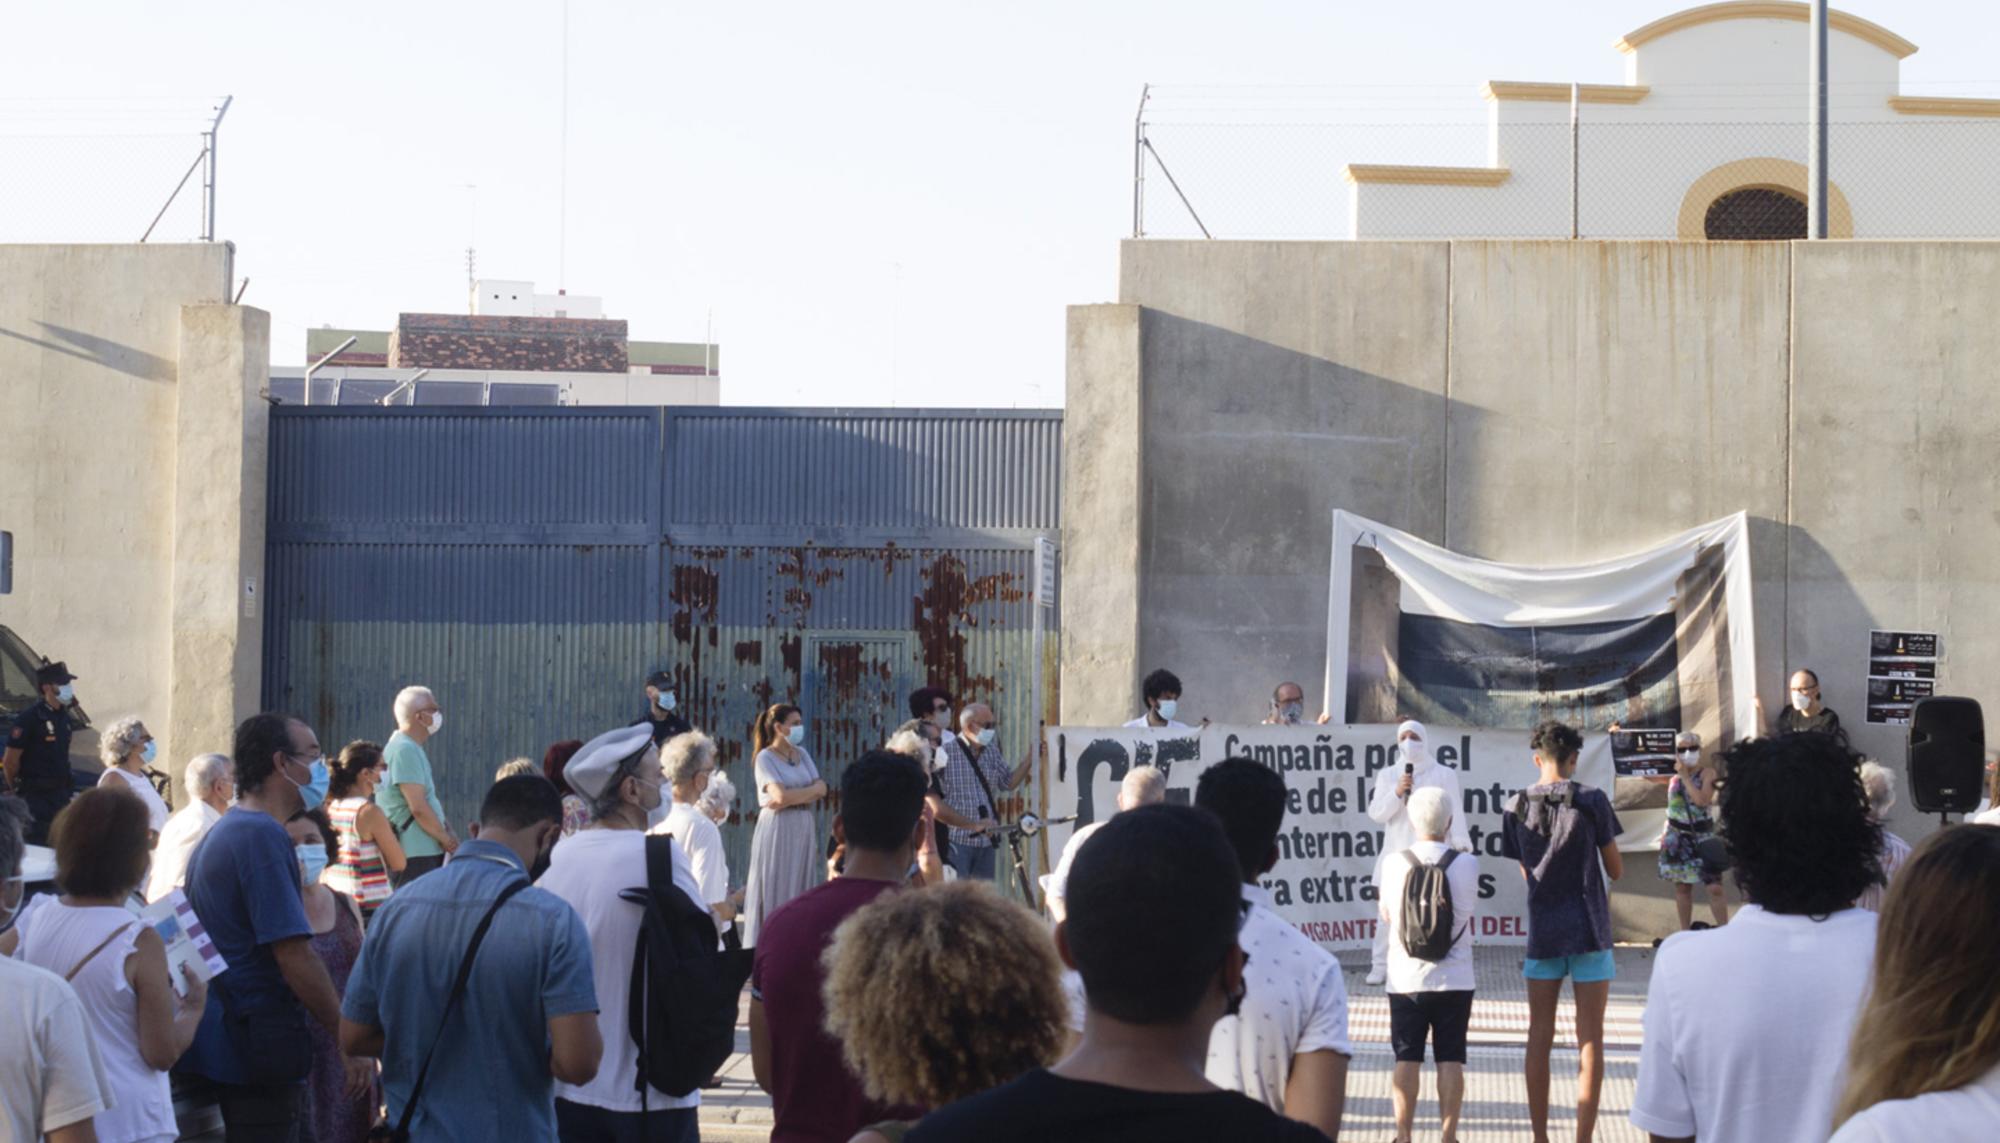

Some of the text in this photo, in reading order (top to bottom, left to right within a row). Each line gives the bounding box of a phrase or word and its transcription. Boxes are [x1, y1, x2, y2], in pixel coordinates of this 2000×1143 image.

[1225, 733, 1356, 774] Campaña
[1436, 734, 1471, 772] el
[1307, 777, 1348, 814] de
[1481, 915, 1528, 937] DEL
